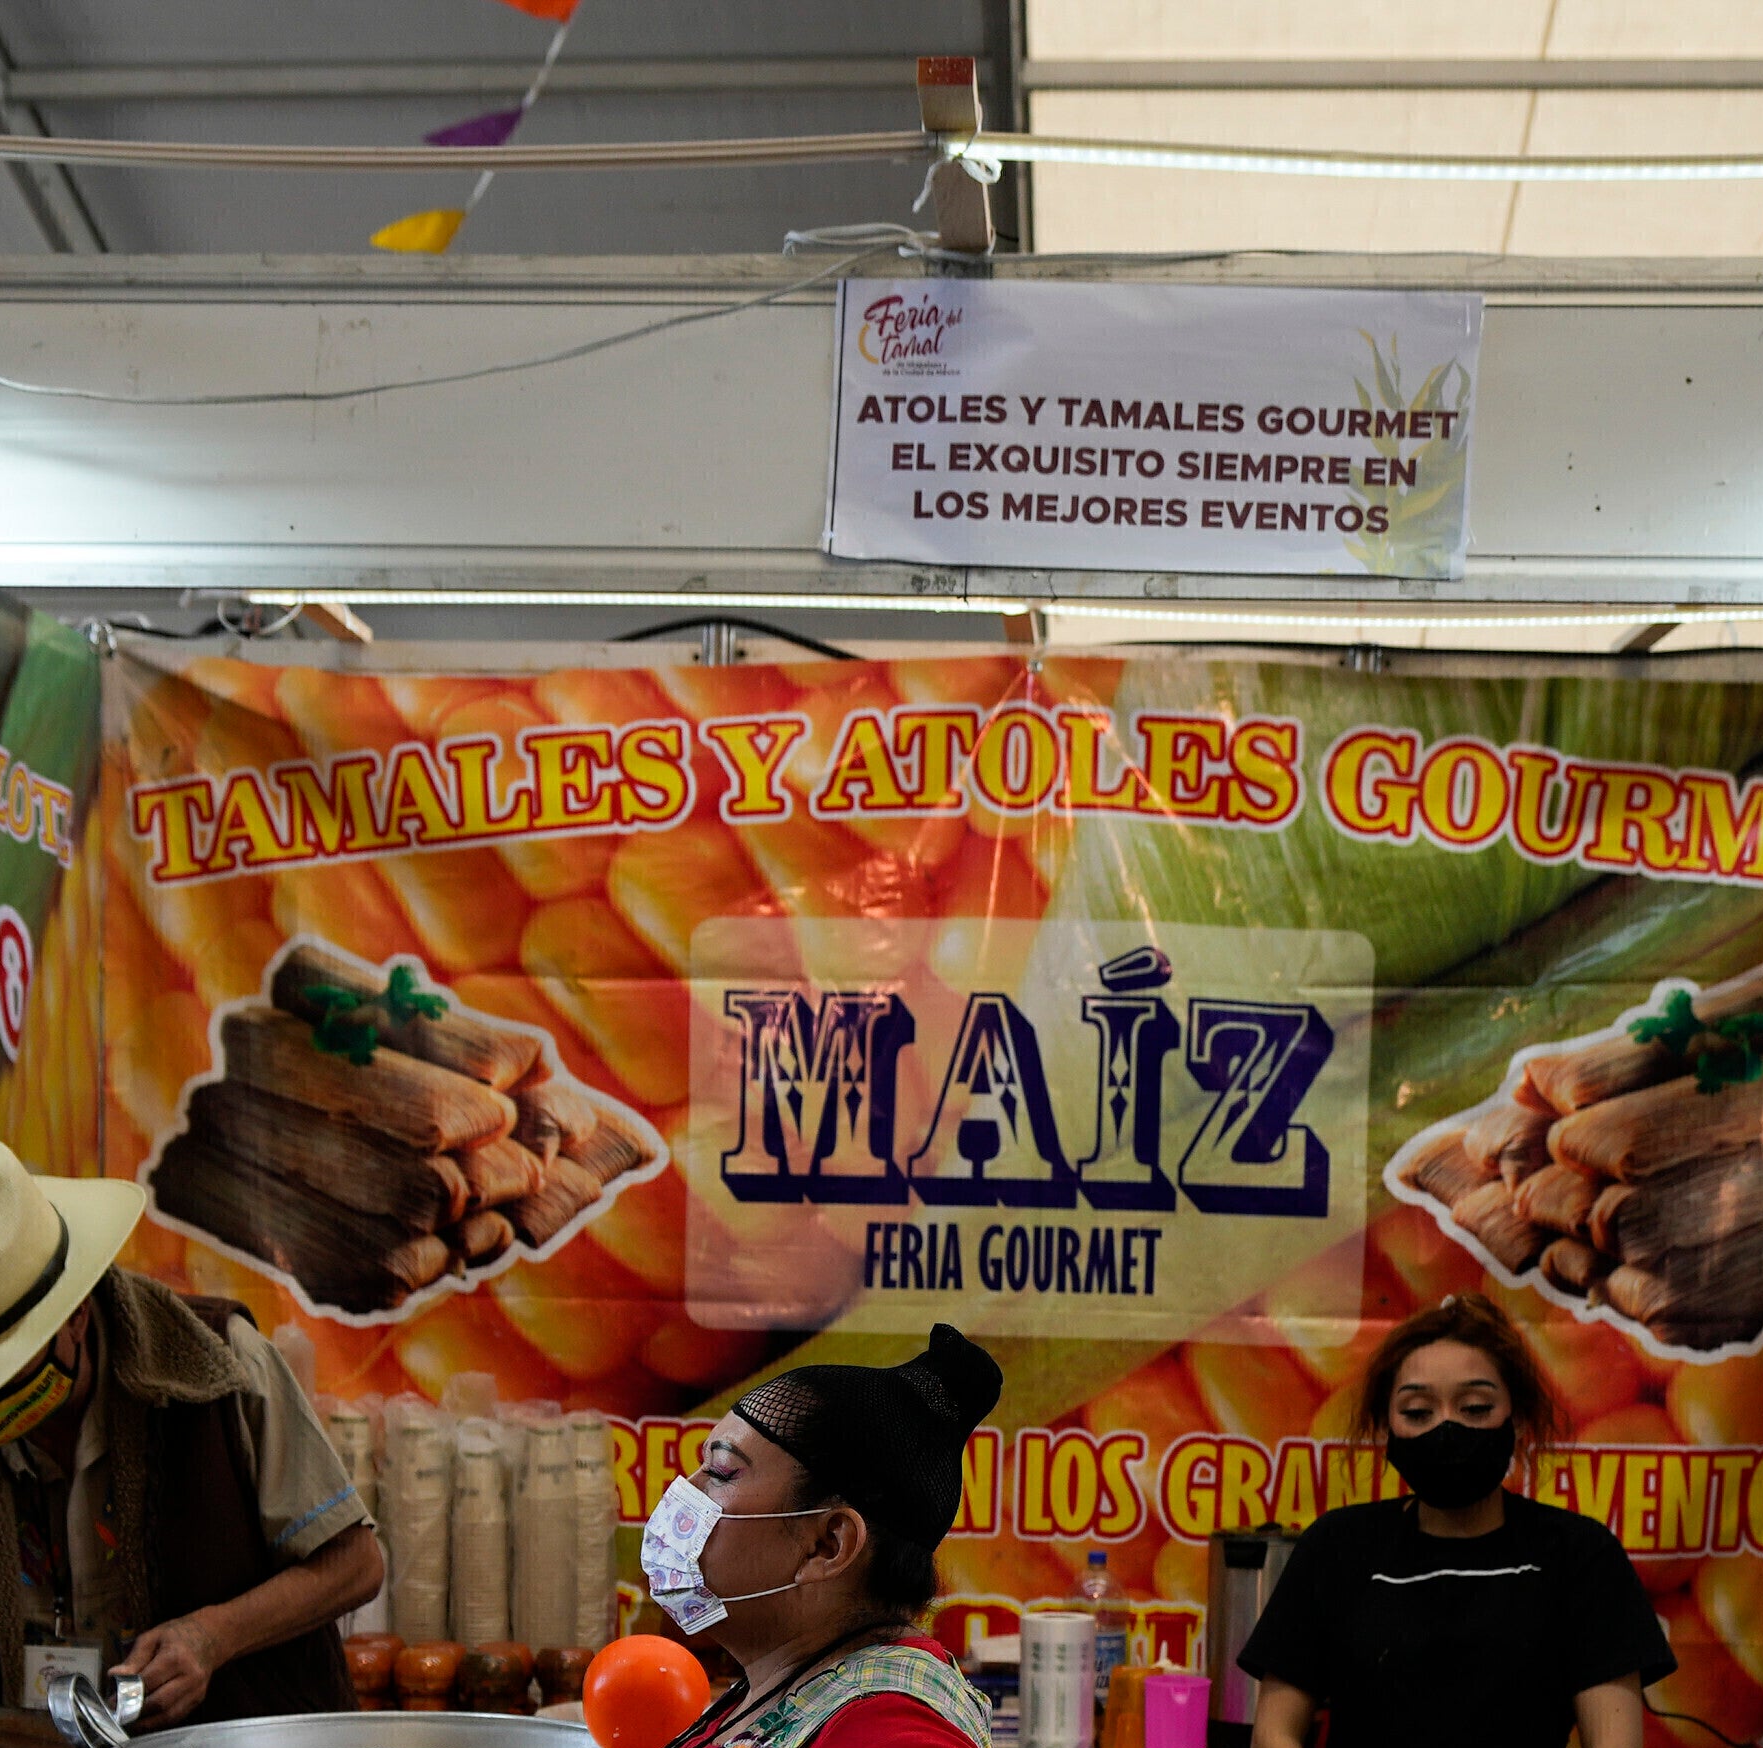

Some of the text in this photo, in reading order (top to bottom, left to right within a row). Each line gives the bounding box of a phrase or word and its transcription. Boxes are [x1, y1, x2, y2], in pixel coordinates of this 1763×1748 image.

[864, 293, 941, 336] Feria
[857, 396, 1458, 440] ATOLES Y TAMALES GOURMET
[891, 443, 1416, 487] EL EXQUISITO SIEMPRE EN
[914, 491, 1389, 534] LOS MEJORES EVENTOS
[137, 725, 684, 883] TAMALES
[711, 721, 804, 815] Y
[812, 709, 1298, 824] ATOLES
[722, 945, 1334, 1217] MAÍZ
[864, 1223, 1161, 1295] FERIA GOURMET
[1019, 1431, 1146, 1541] LOS
